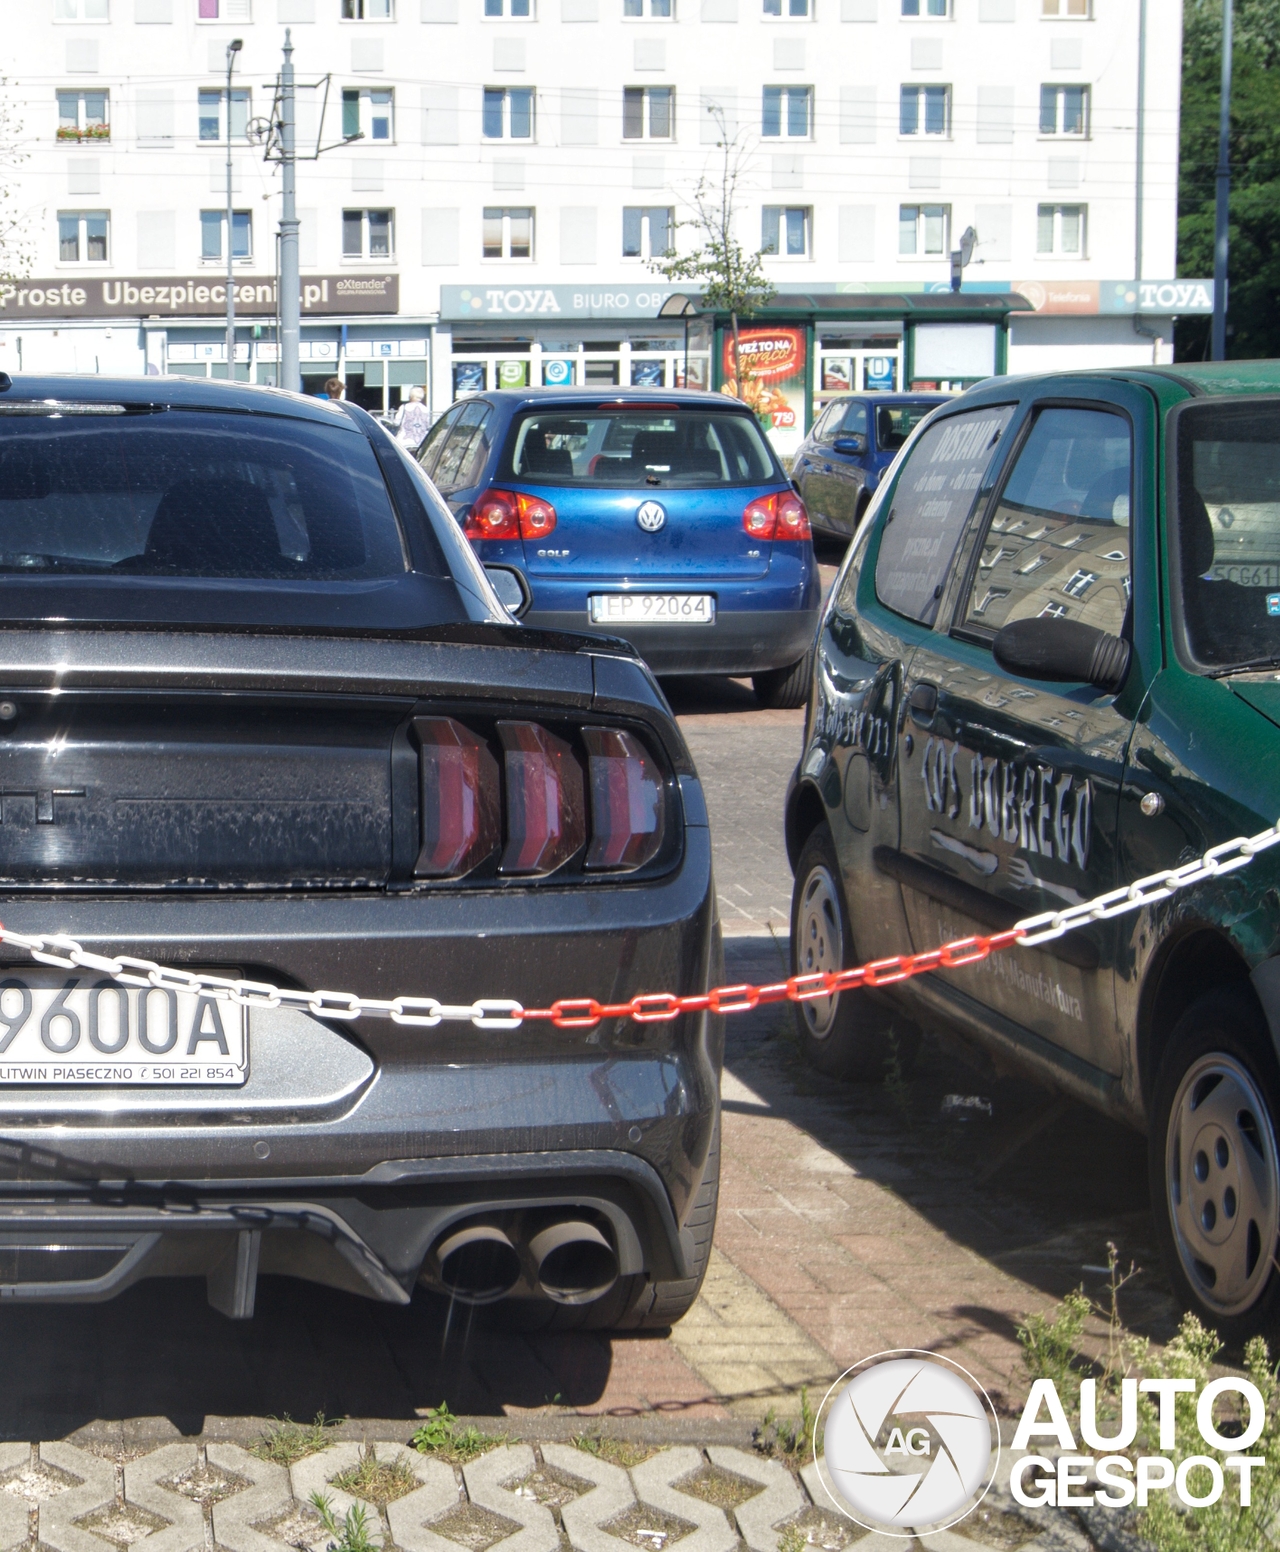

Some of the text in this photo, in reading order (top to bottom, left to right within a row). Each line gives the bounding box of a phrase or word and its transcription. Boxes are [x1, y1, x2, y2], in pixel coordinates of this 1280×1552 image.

[0, 279, 329, 309] Proste Ubezpieczeni.pl
[486, 290, 561, 313] TOYA
[573, 293, 630, 309] BIURO
[1139, 284, 1212, 307] TOYA
[758, 341, 774, 352] TO
[774, 339, 790, 350] NA
[930, 419, 1002, 463] DOSTAWY
[537, 549, 570, 558] GOLF
[607, 596, 633, 616] EP
[643, 596, 705, 616] 92064
[969, 752, 1091, 872] DOBREGO
[0, 1067, 48, 1080] LITWIN
[53, 1068, 133, 1080] PIASECZNO
[152, 1068, 175, 1080] 501
[180, 1068, 201, 1080] 221
[207, 1068, 234, 1080] 854
